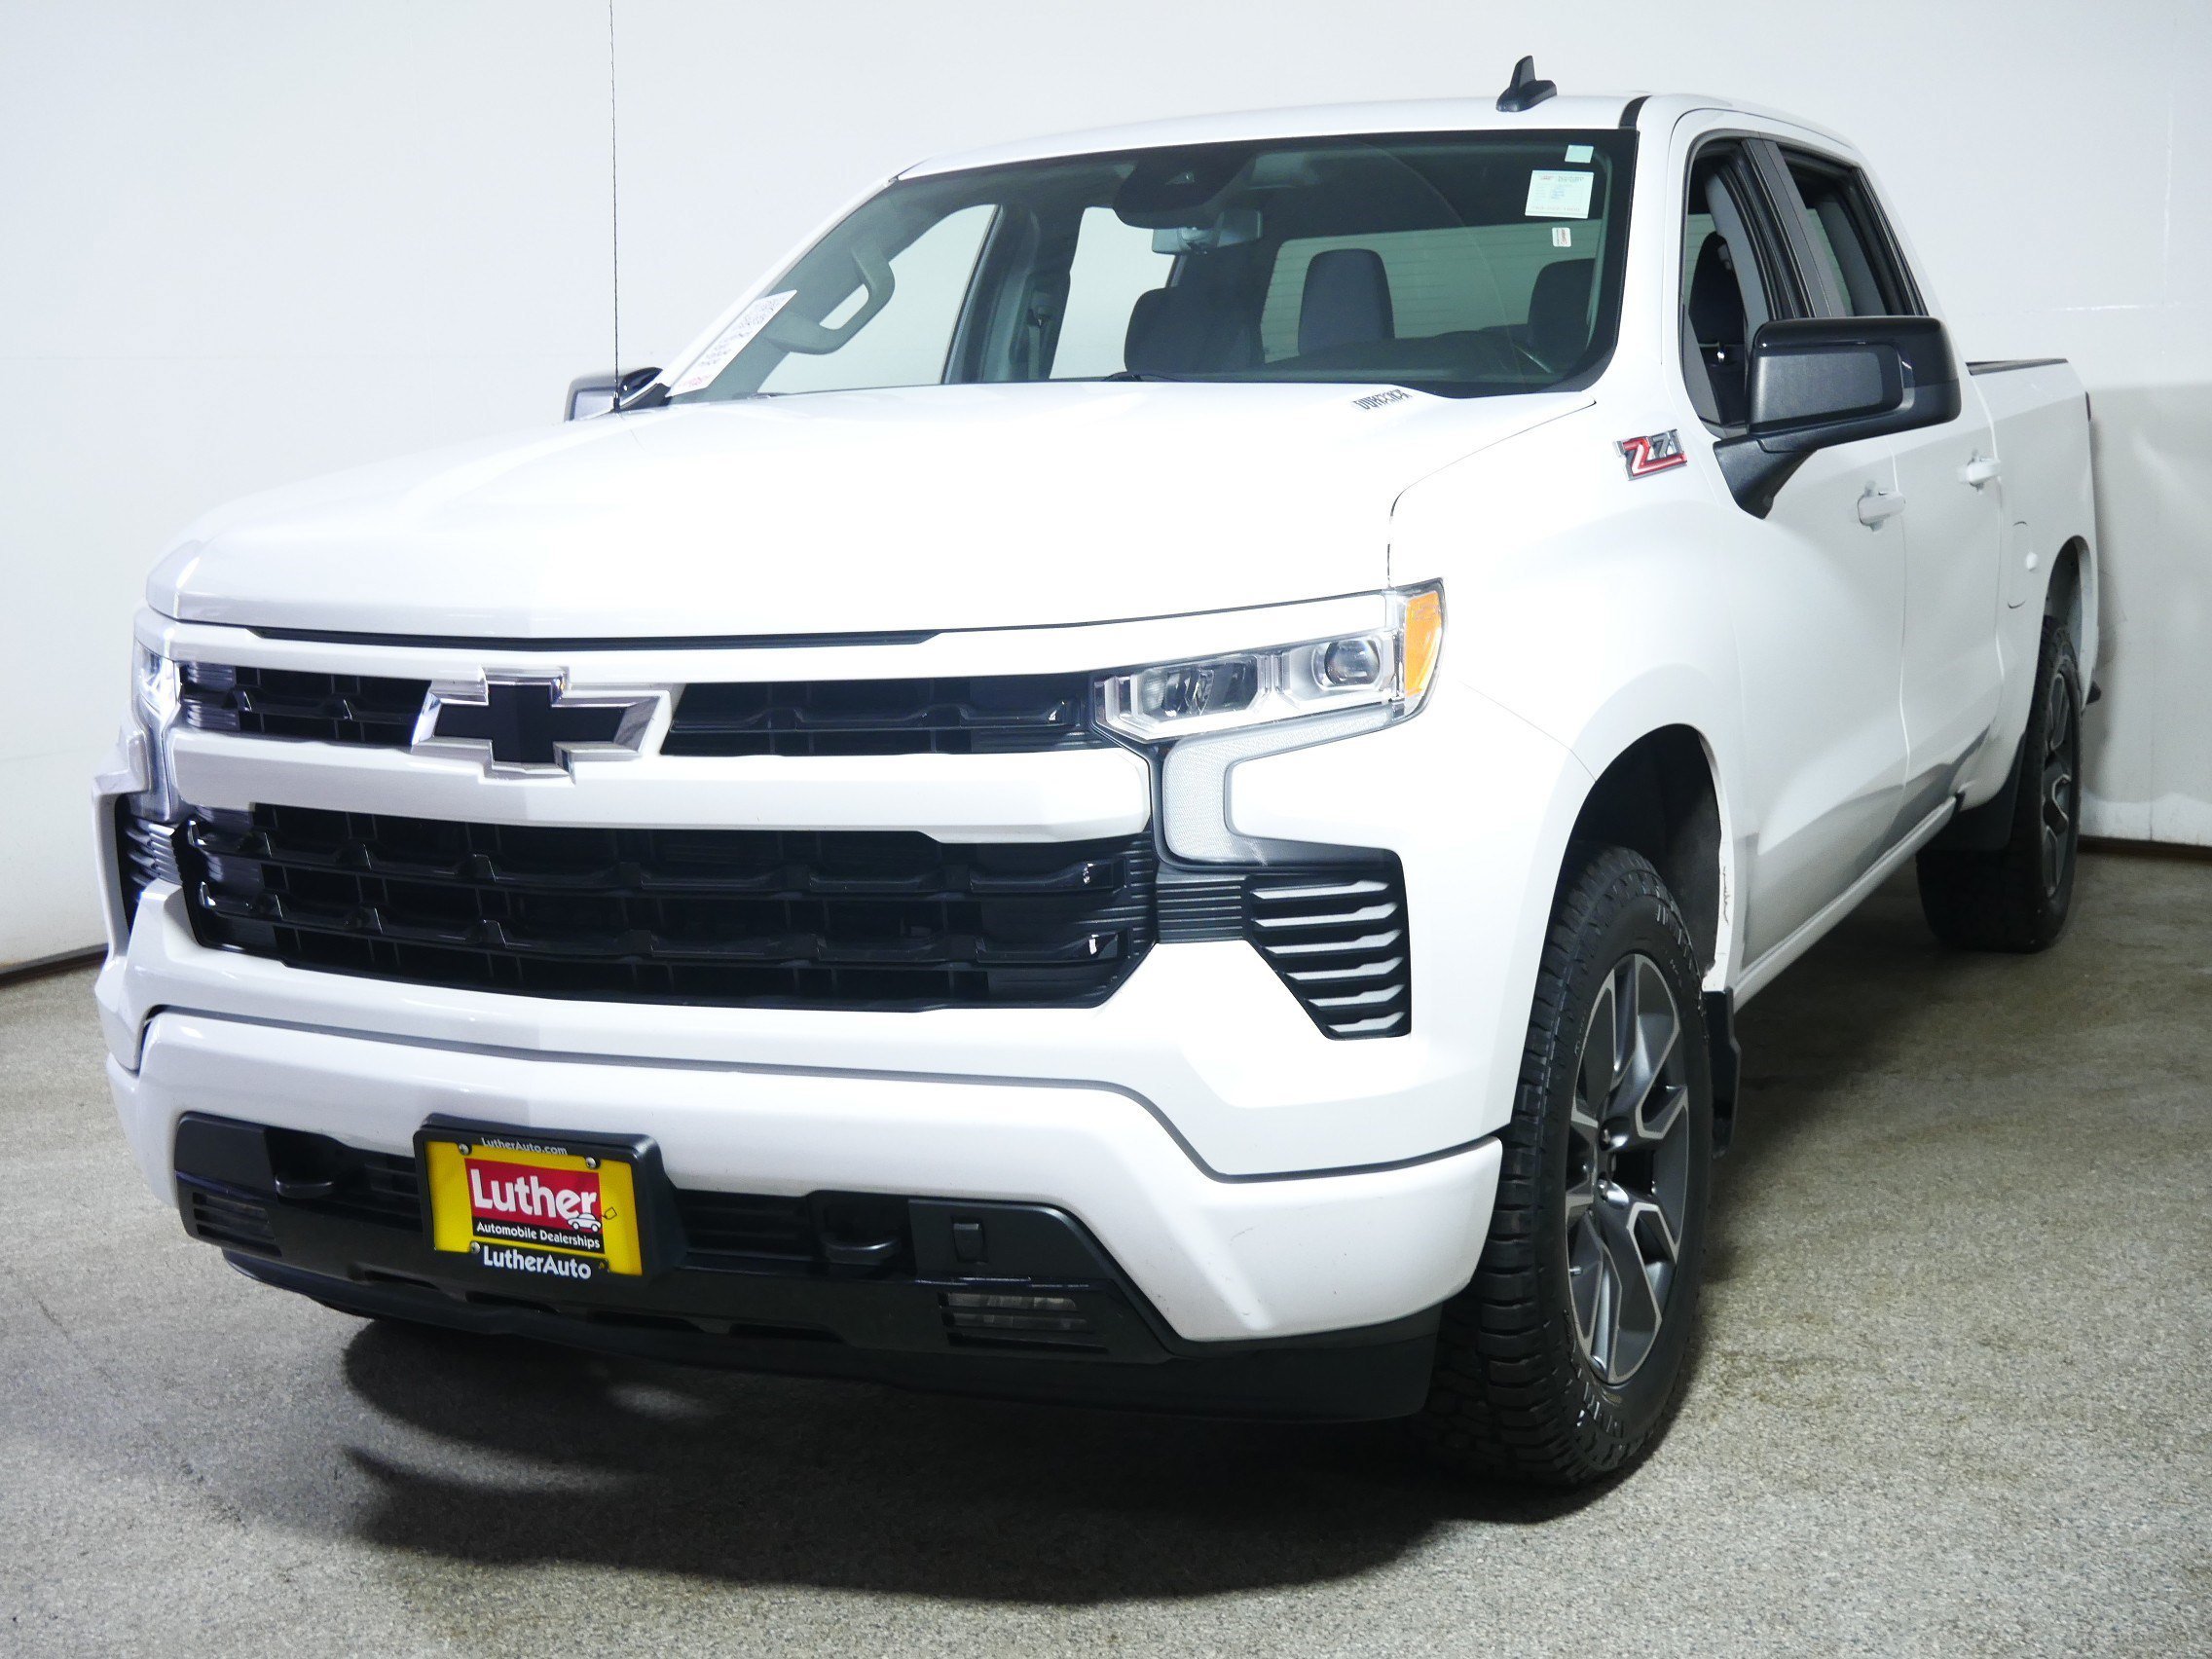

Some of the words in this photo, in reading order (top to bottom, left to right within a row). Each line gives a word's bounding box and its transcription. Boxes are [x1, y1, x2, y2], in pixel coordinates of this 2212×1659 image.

[481, 1137, 569, 1156] LutherAuto.com
[469, 1168, 597, 1220] Luther
[476, 1221, 537, 1240] Automobile
[538, 1229, 601, 1249] Dealerships
[483, 1245, 592, 1280] LutherAuto
